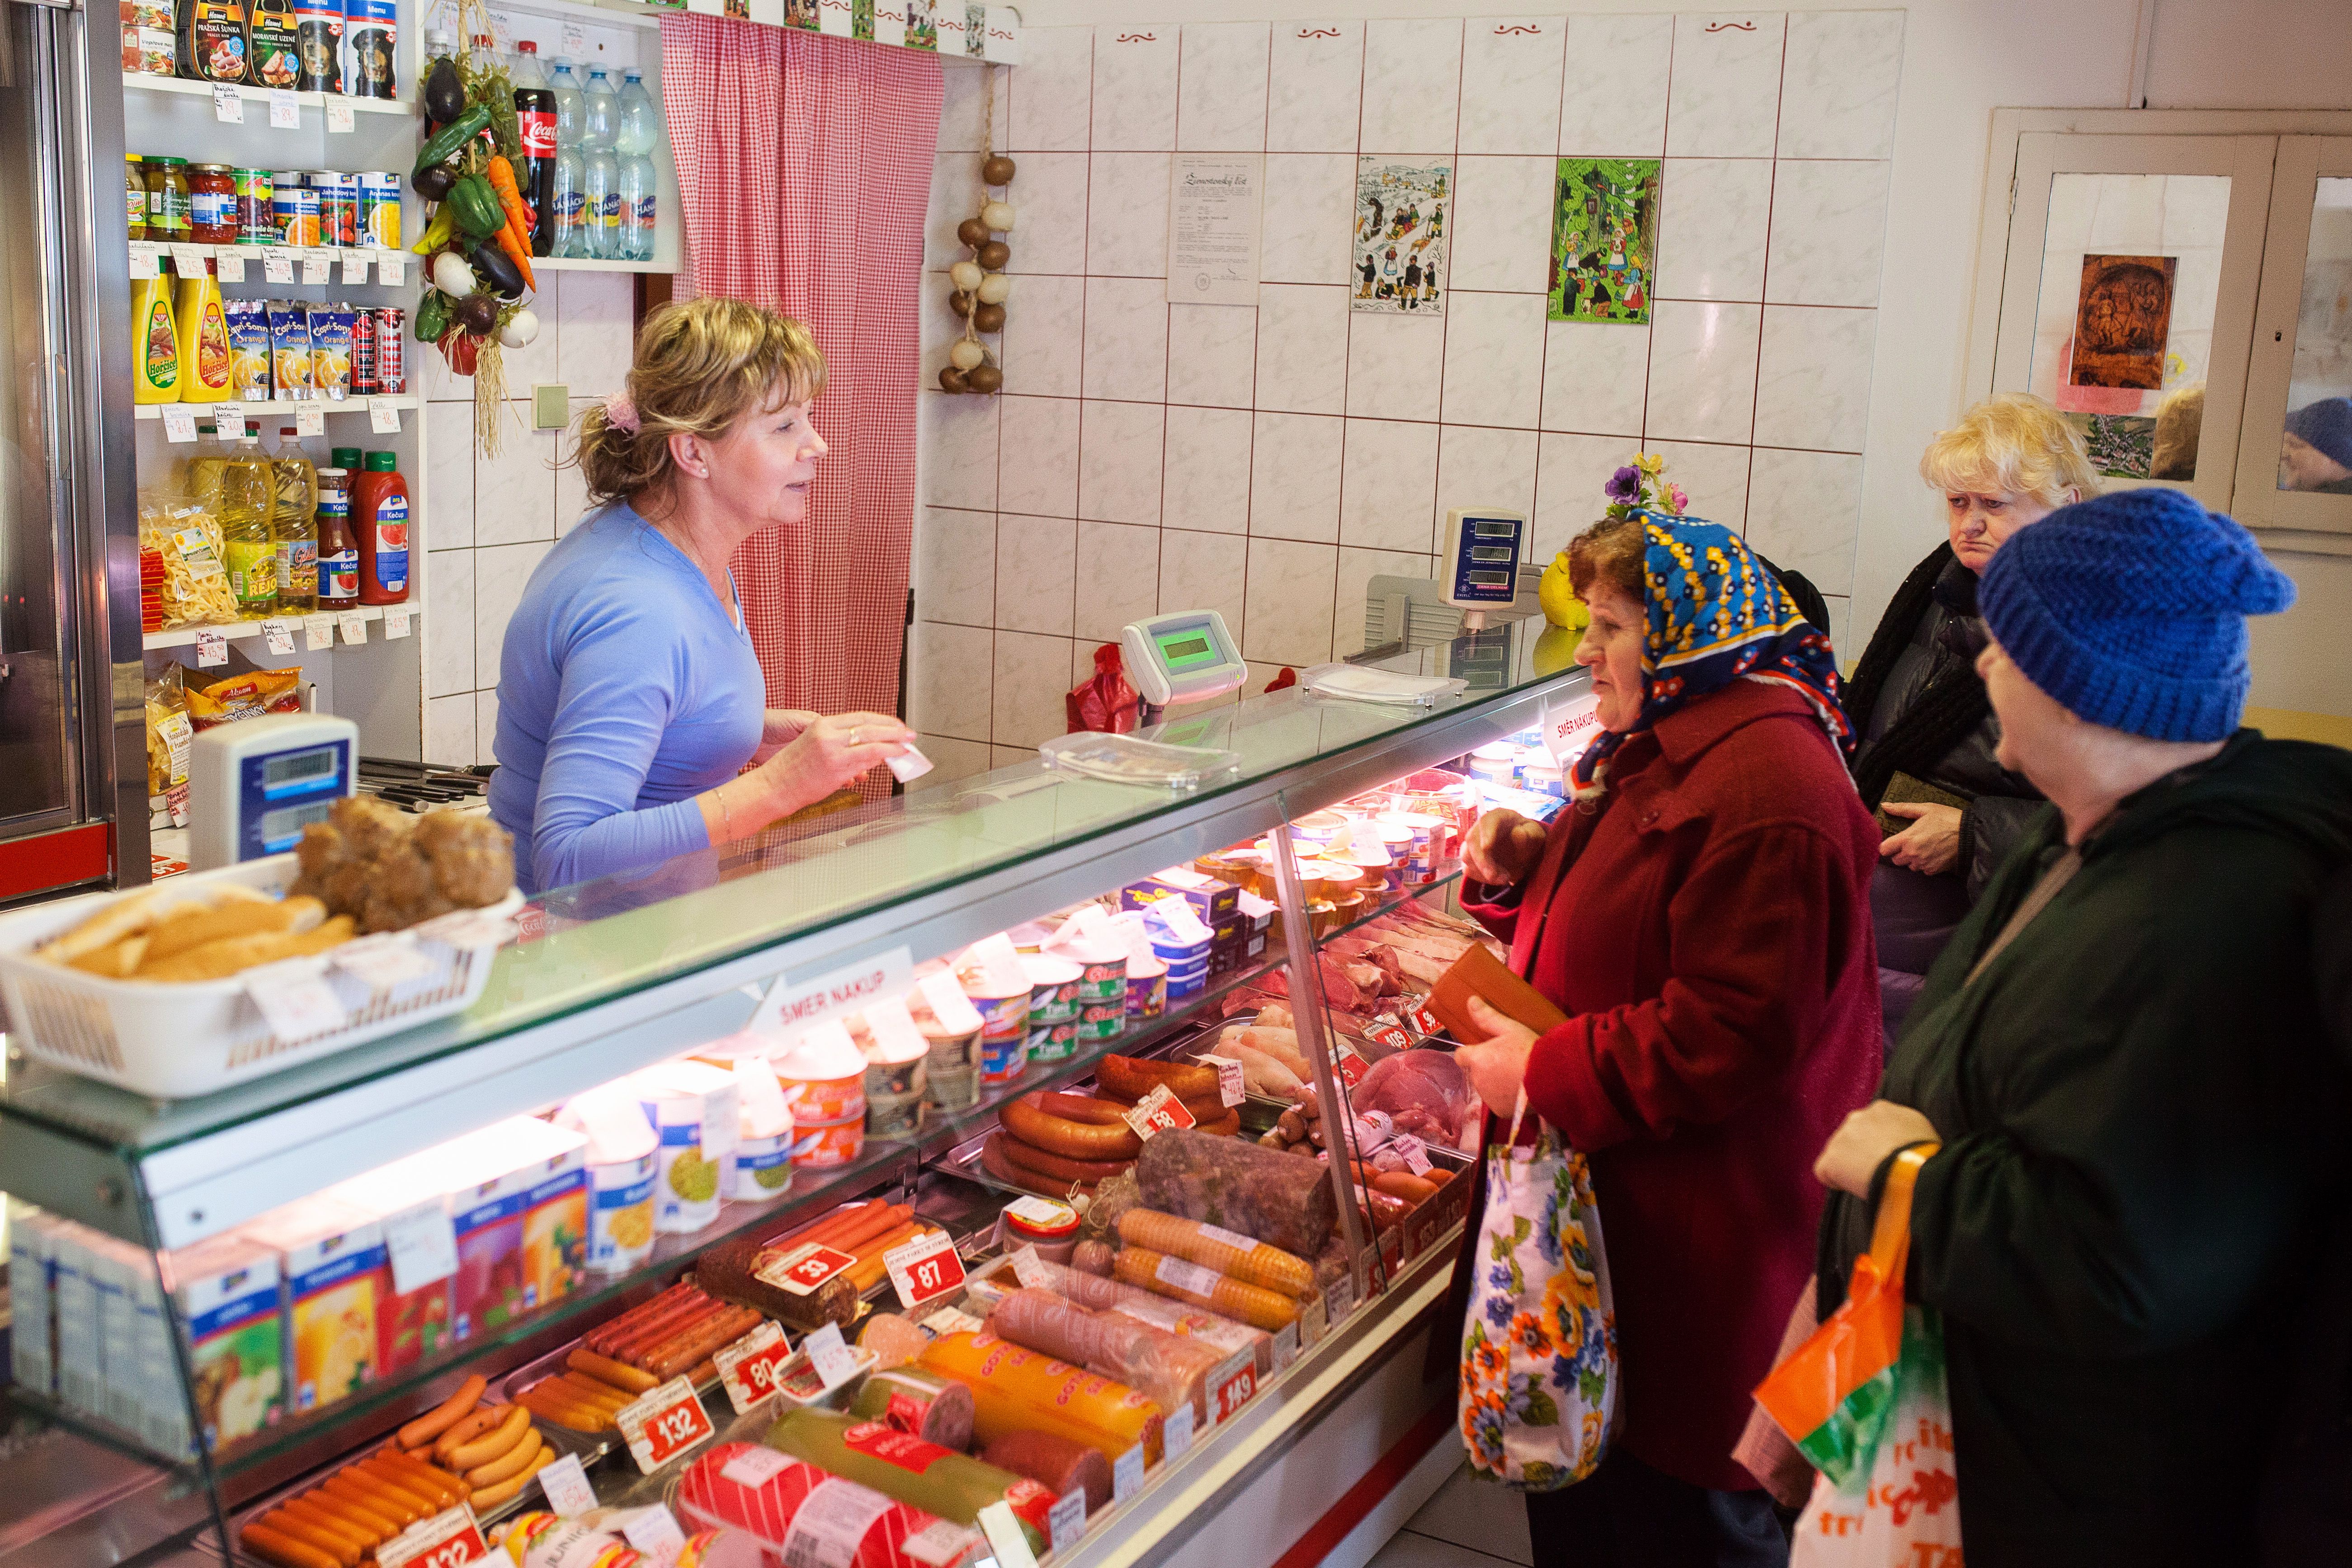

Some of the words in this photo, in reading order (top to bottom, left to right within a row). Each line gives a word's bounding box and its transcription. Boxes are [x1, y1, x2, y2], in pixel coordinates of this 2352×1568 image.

[208, 11, 226, 20] Hamé
[368, 5, 386, 14] Menu
[198, 24, 221, 33] PRAŽSKÁ
[221, 25, 240, 33] ŠUNKA
[264, 19, 282, 28] Hamé
[252, 32, 278, 42] MORAVSKÉ
[278, 34, 296, 43] UZENÉ
[359, 335, 375, 381] HELL
[382, 332, 401, 376] HELL
[149, 361, 177, 377] Hořčice
[203, 361, 229, 377] Hořčice
[387, 511, 404, 519] Kečup
[340, 562, 357, 570] Kečup
[1557, 721, 1575, 739] SMĚR
[1385, 1030, 1406, 1048] 109
[1153, 1110, 1175, 1128] 58
[918, 1259, 942, 1289] 87
[750, 1358, 774, 1389] 80
[1227, 1373, 1251, 1410] 149
[658, 1407, 698, 1449] 132
